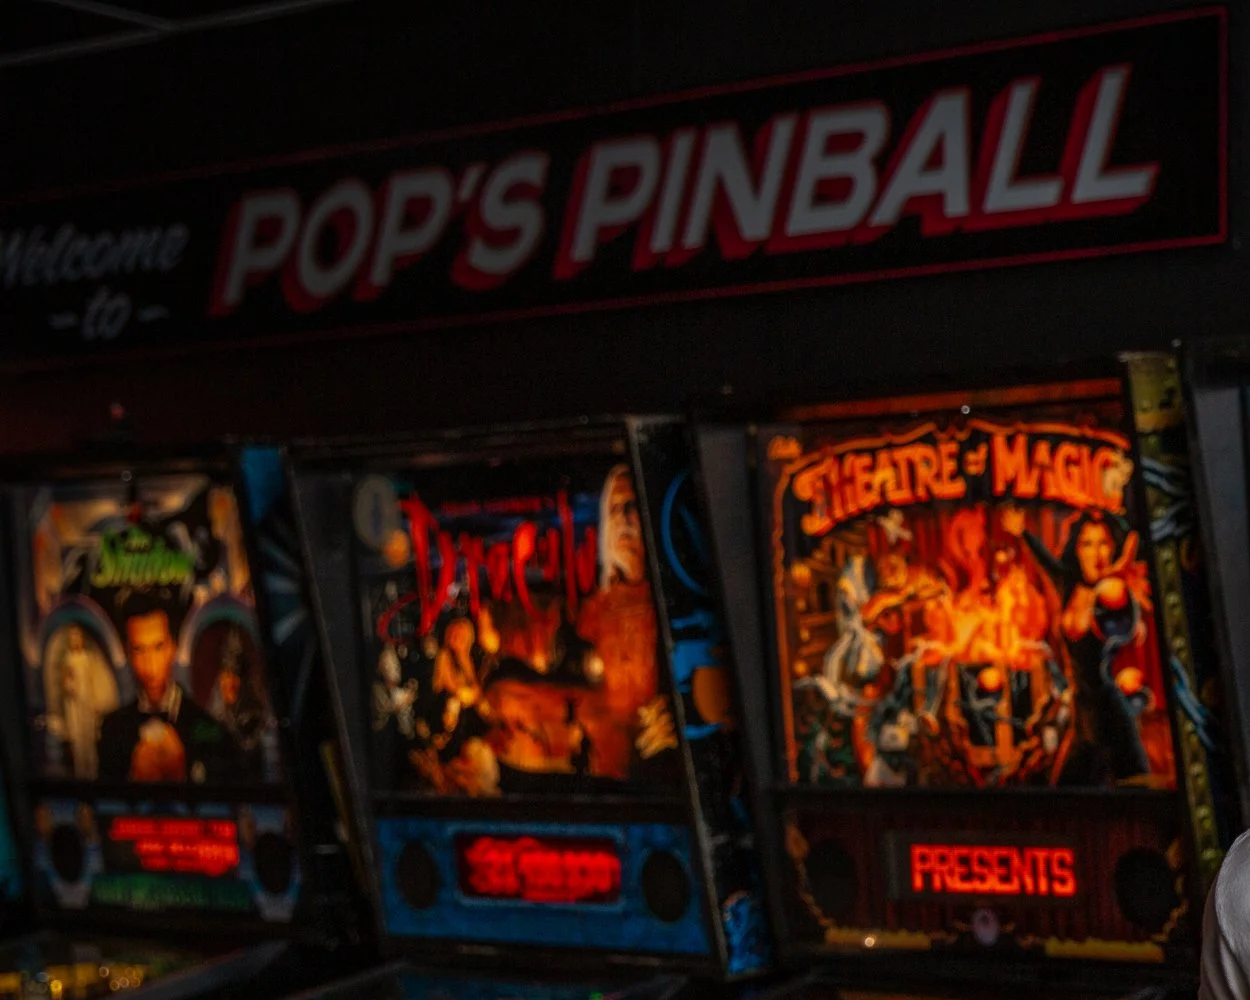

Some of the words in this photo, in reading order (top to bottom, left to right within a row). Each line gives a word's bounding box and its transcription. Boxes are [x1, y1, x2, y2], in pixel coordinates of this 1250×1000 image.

[209, 149, 551, 318] POP'S
[556, 61, 1160, 280] PINBALL
[792, 434, 967, 537] THEATRE
[990, 432, 1130, 513] MAGIC
[910, 843, 1077, 898] PRESENTS
